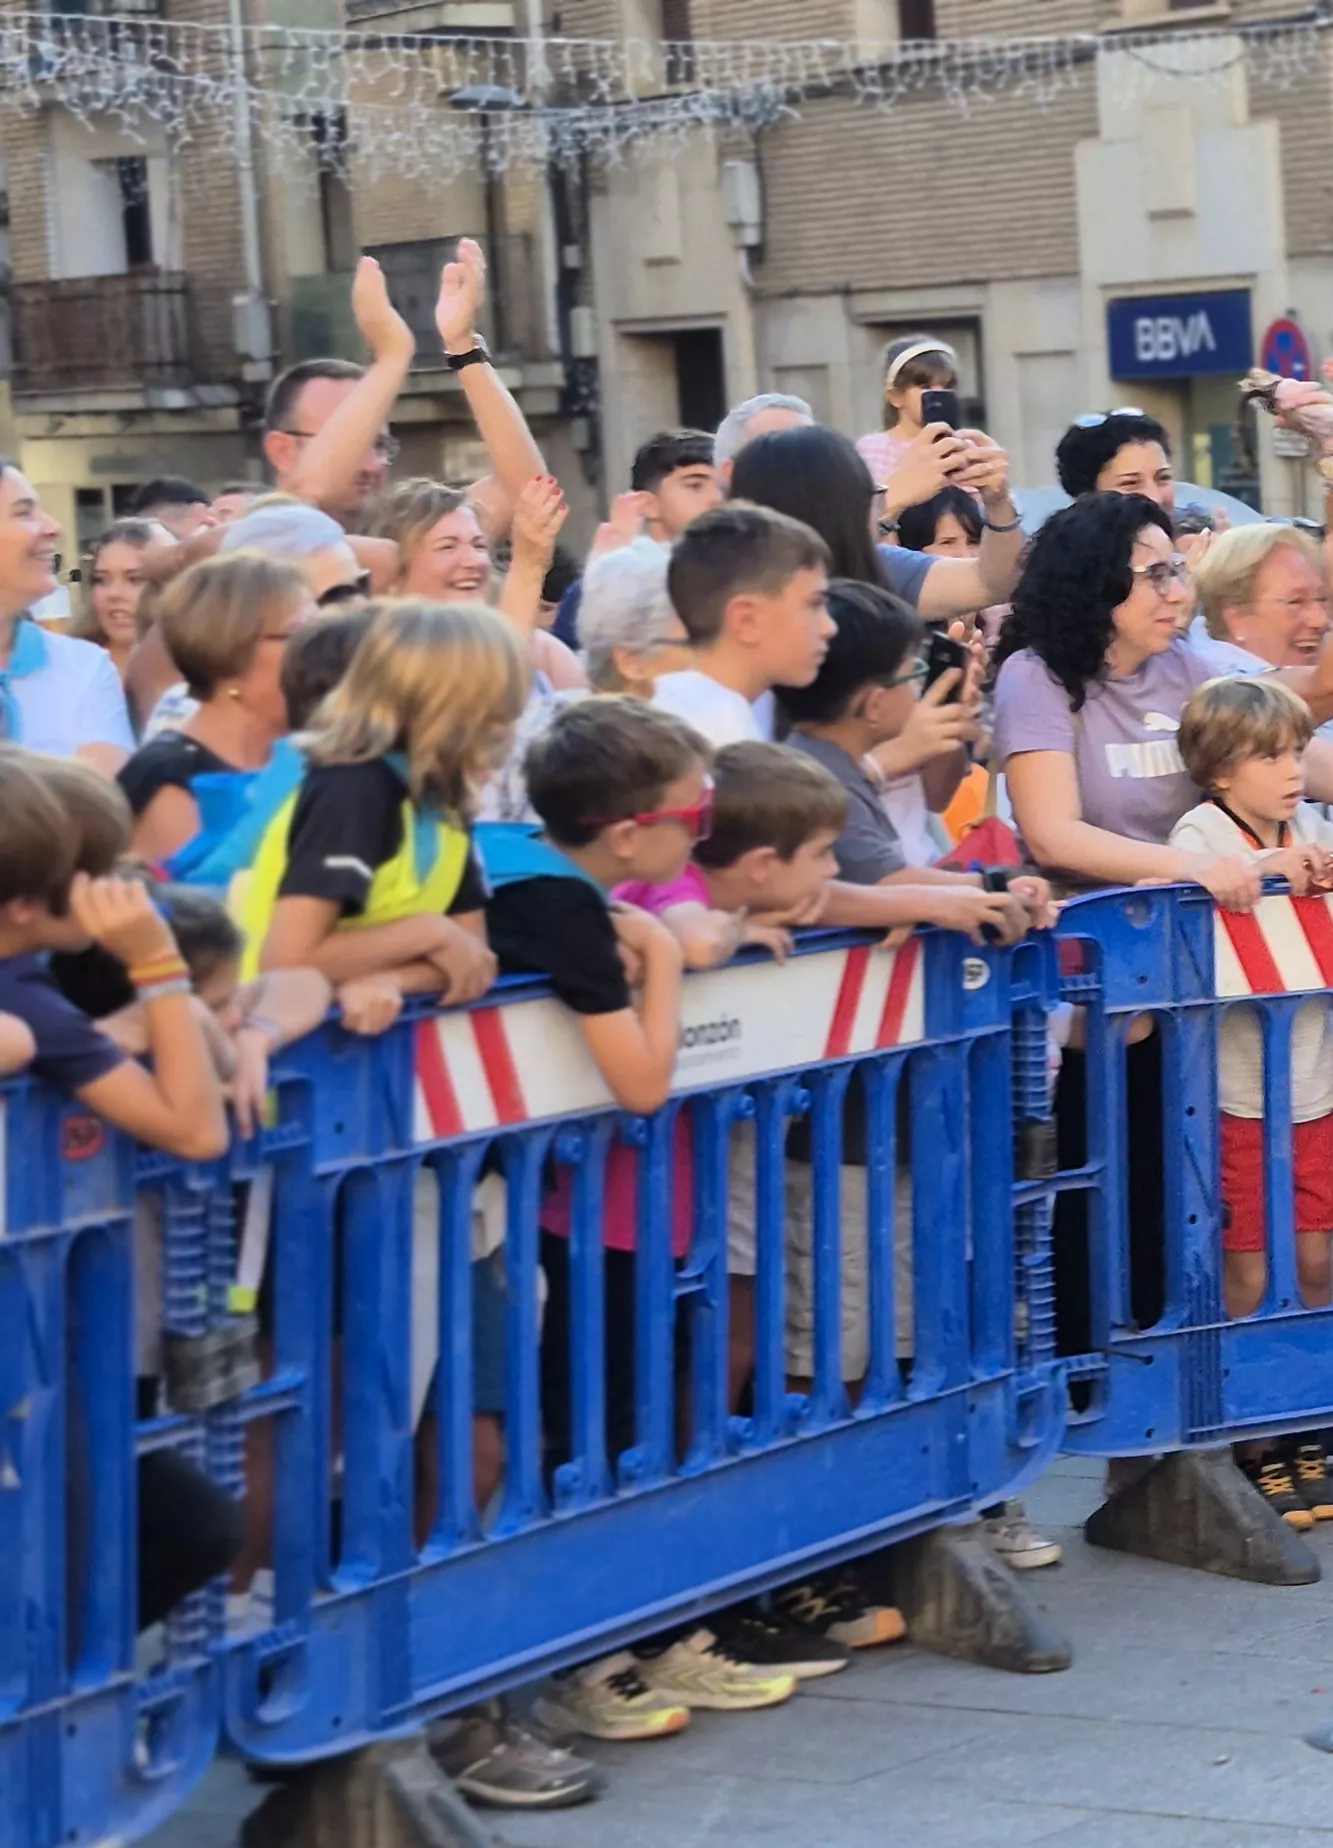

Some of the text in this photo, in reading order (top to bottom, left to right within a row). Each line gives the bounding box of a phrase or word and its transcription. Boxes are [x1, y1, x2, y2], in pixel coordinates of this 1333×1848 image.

[1135, 310, 1218, 361] BBVA
[1104, 739, 1187, 778] PUM
[678, 1012, 742, 1048] onzón
